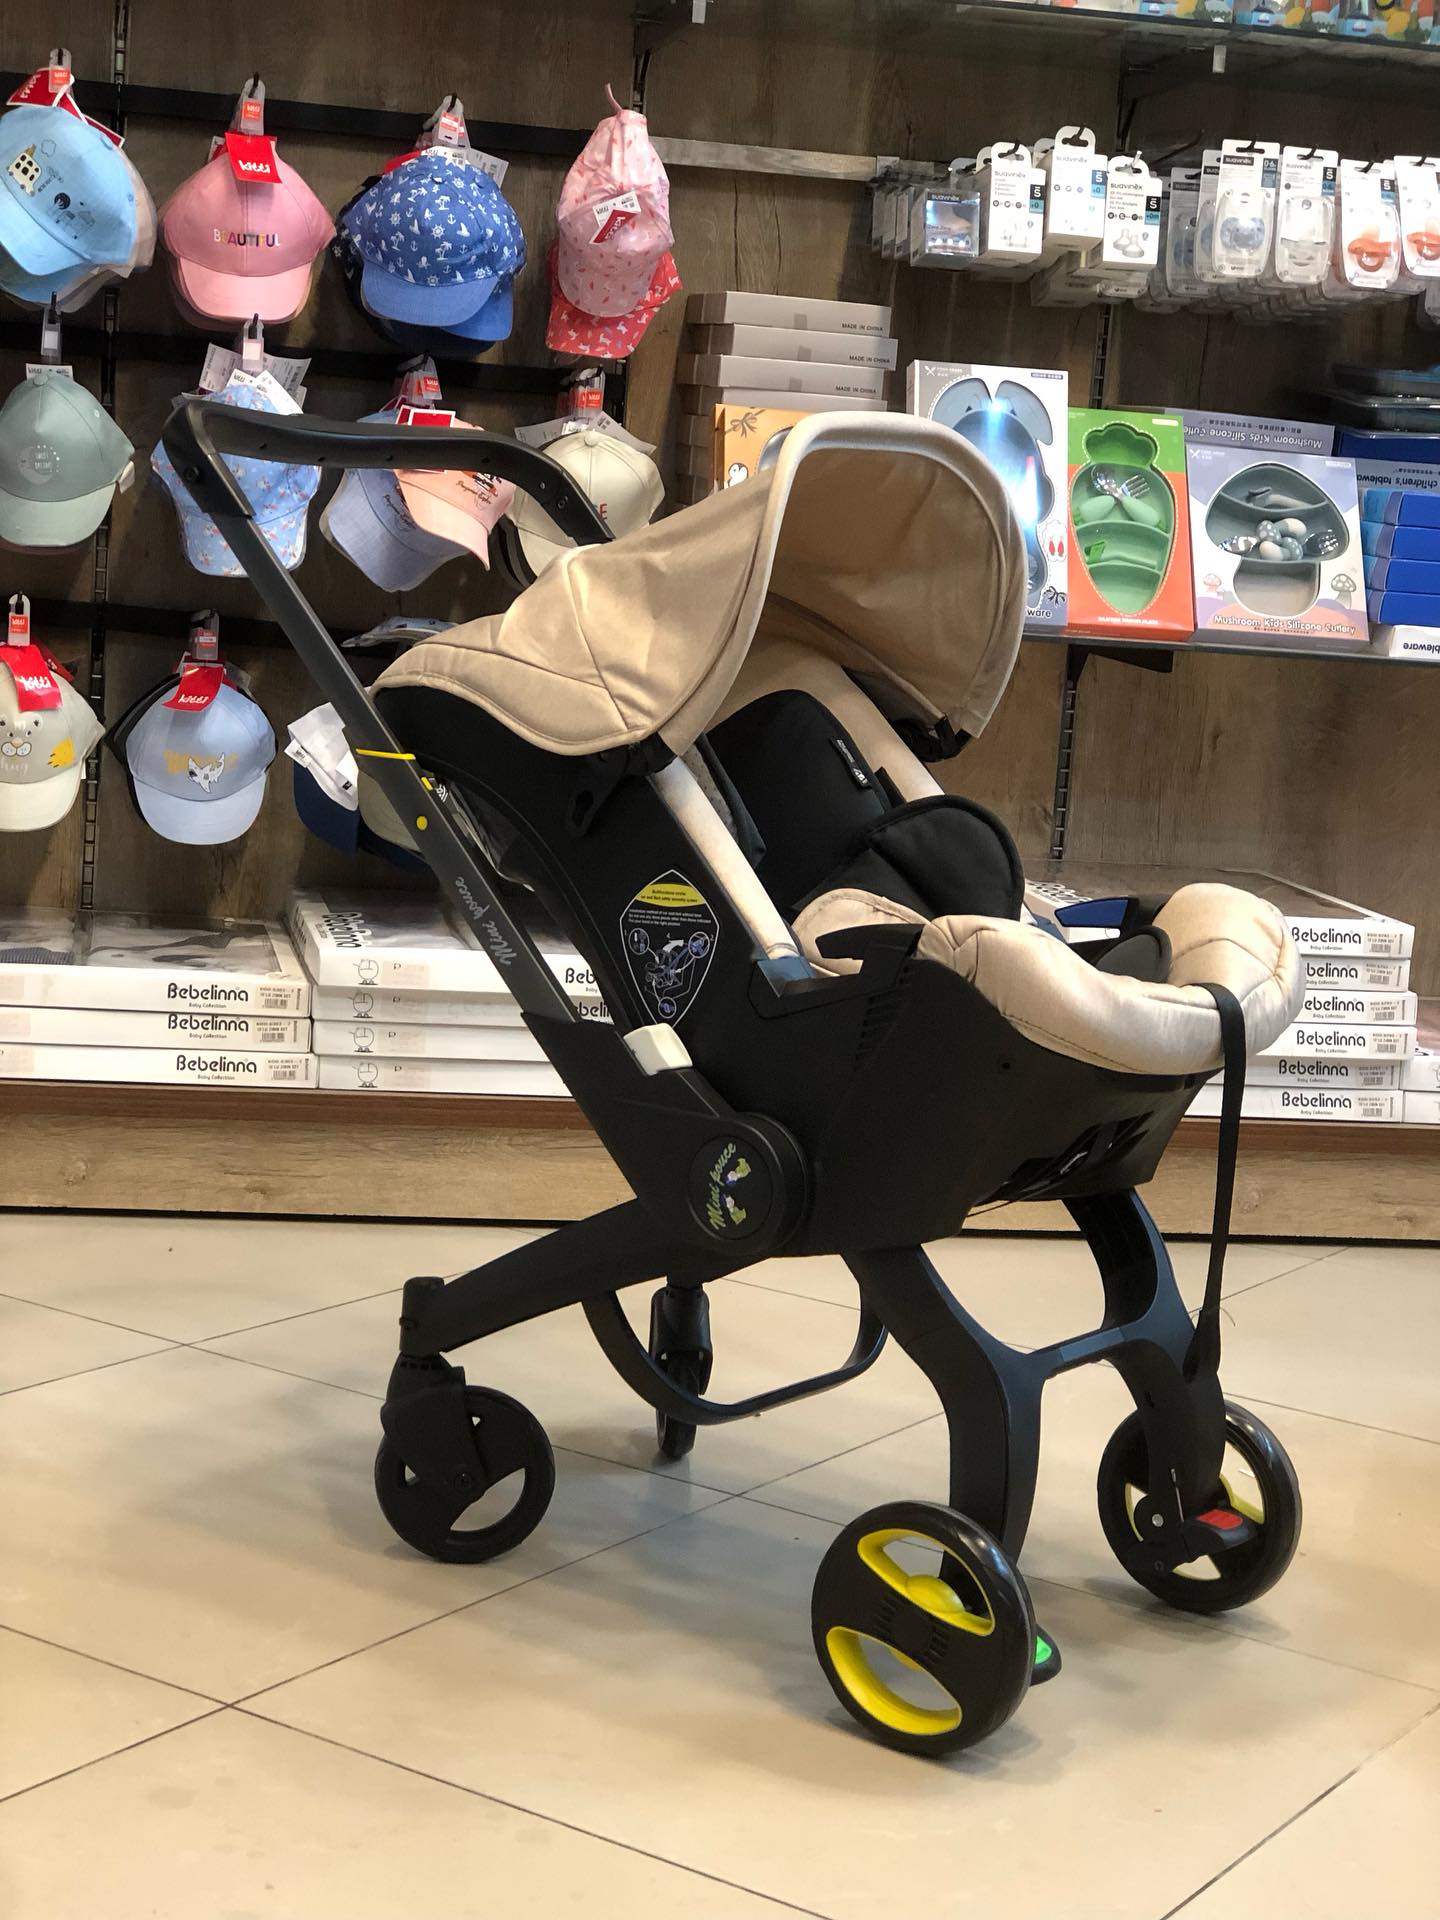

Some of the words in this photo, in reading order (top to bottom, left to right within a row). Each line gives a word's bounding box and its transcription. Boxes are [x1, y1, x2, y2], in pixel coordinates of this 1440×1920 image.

[238, 159, 271, 174] kitti
[213, 228, 281, 248] BEAUTIFUL
[841, 322, 857, 330] MADE
[1209, 429, 1246, 441] Silicone
[1249, 433, 1270, 443] Kids
[1273, 435, 1323, 449] Mushroom
[1394, 476, 1438, 489] children's
[1214, 615, 1261, 626] Mushroom
[1264, 619, 1284, 628] Kids
[1287, 620, 1322, 631] Silicone
[1325, 623, 1356, 636] Cutlery
[1291, 926, 1362, 945] Bebelinna
[1306, 962, 1358, 979] belinna
[167, 982, 249, 1002] Bebelinna
[1304, 996, 1365, 1012] ebelinna
[168, 1013, 249, 1033] Bebelinna
[1296, 1029, 1366, 1047] Bebelinna
[176, 1054, 257, 1074] Bebelinna
[1278, 1059, 1349, 1077] Bebelinna
[1281, 1091, 1352, 1109] Bebelinna
